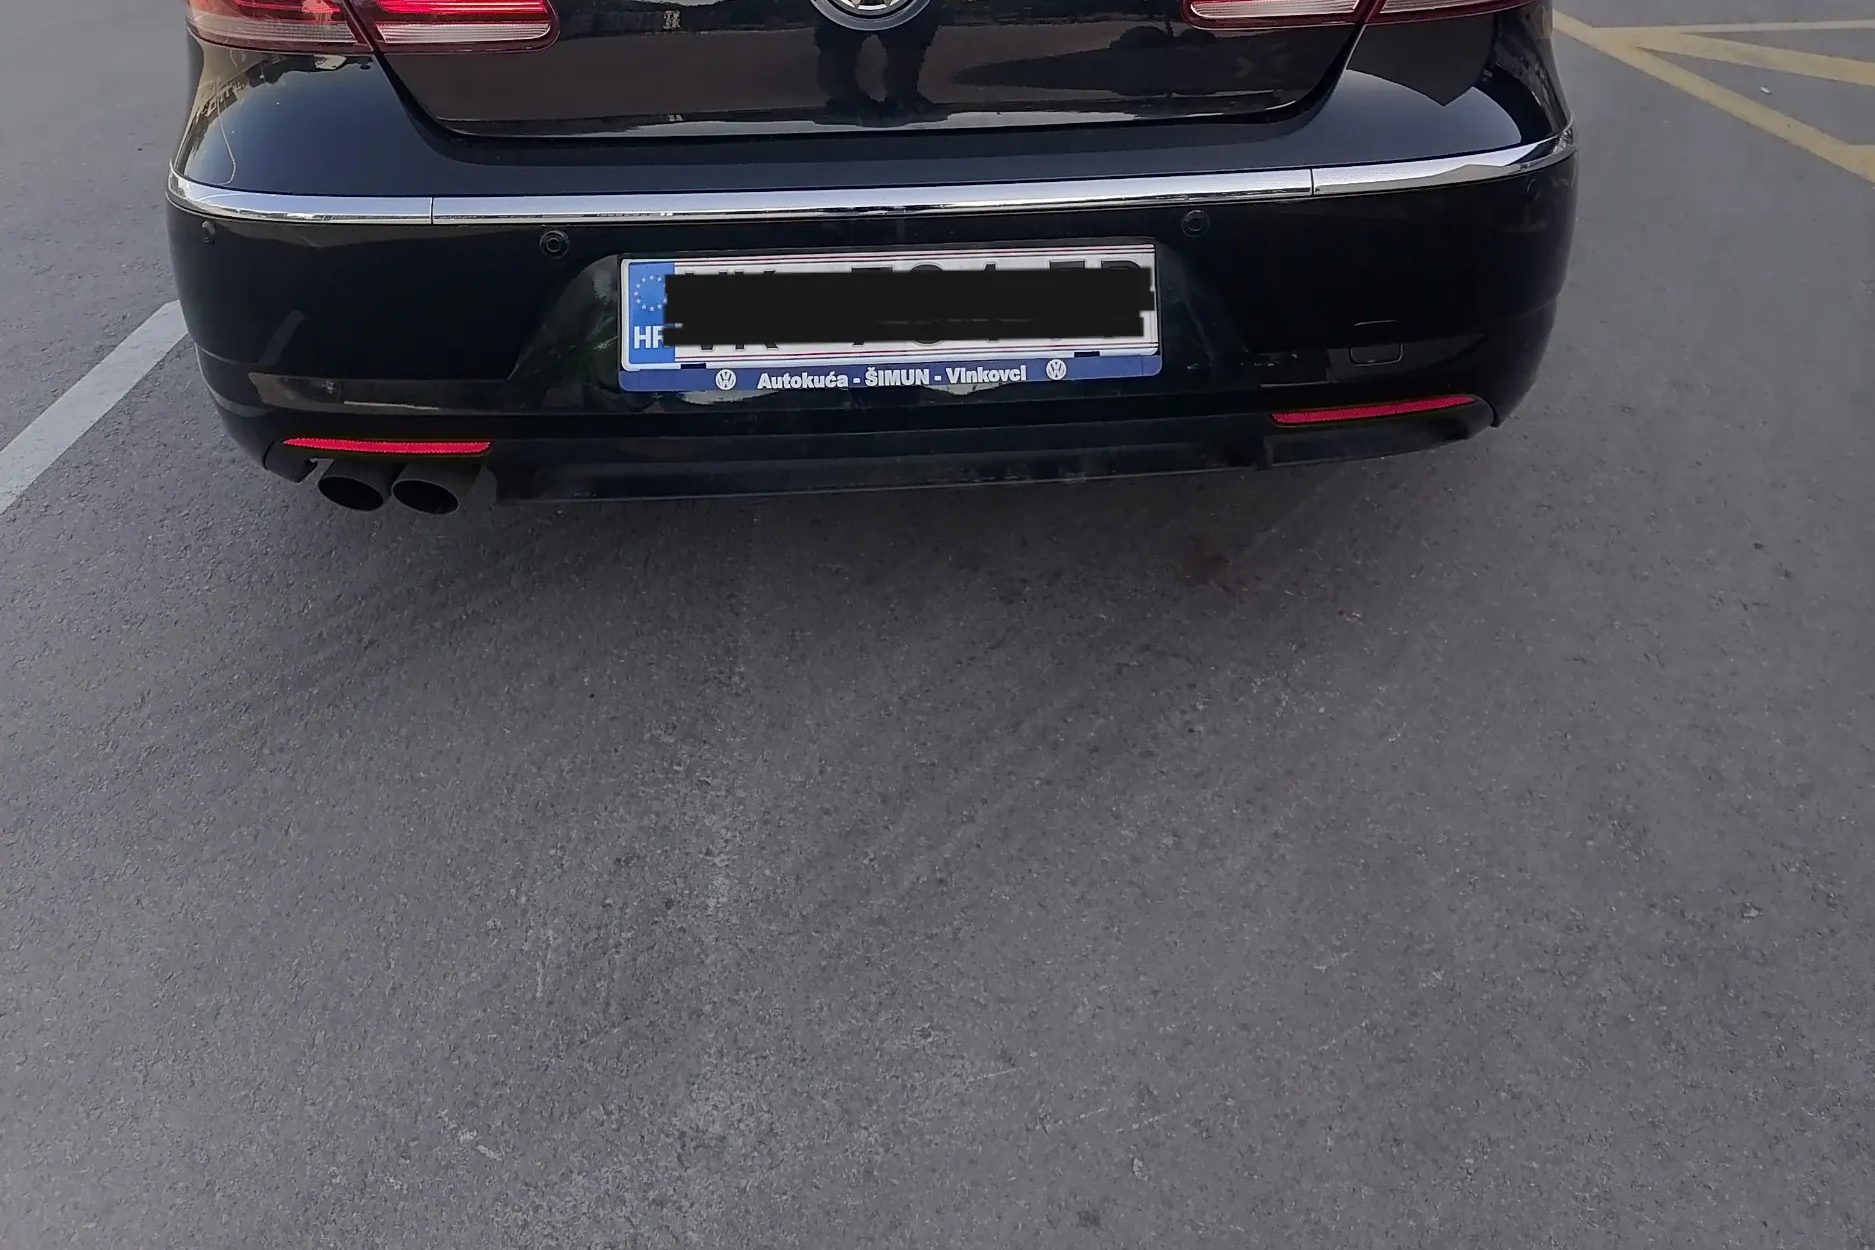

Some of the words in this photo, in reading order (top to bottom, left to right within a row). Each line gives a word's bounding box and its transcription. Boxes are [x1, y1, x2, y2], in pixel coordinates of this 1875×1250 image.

[757, 371, 849, 390] Autokuća
[865, 367, 930, 386] ŠIMUN
[946, 365, 1027, 384] Vinkovci
